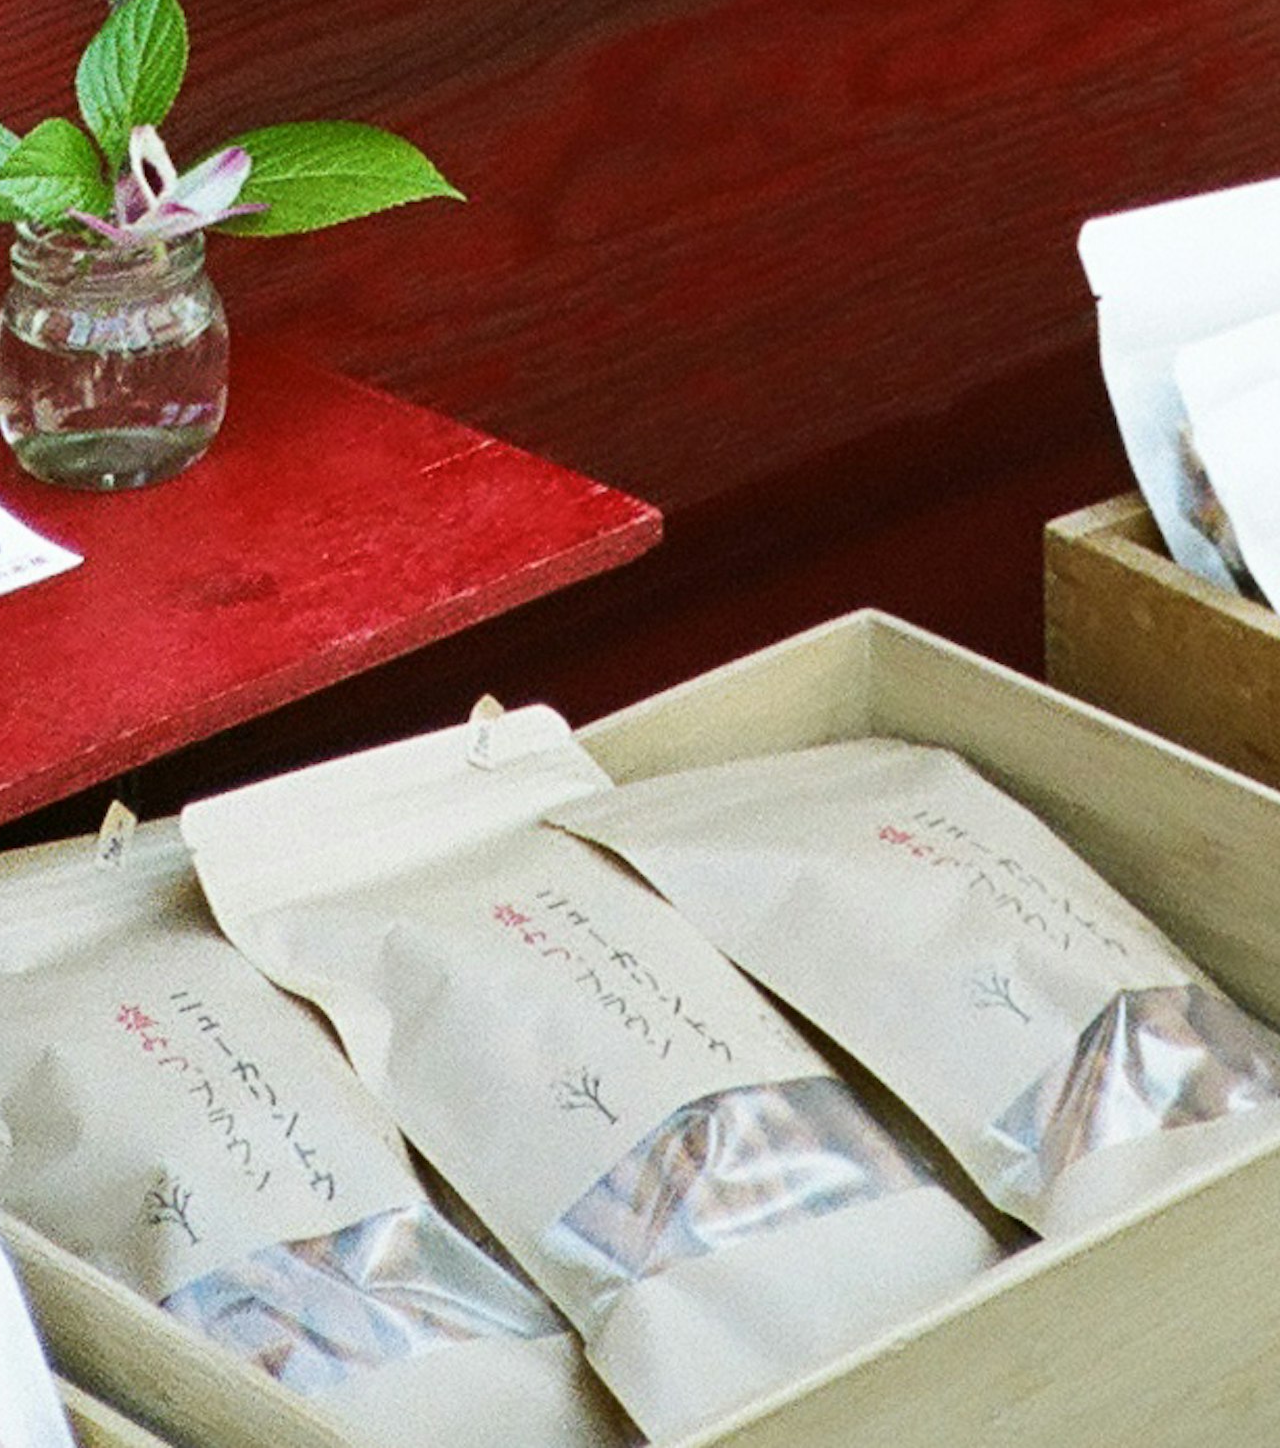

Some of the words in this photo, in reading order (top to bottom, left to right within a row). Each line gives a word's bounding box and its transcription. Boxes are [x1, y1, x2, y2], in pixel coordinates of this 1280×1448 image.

[912, 810, 1129, 957] ニューカリントウ
[536, 890, 733, 1063] ニューカリントウ
[169, 991, 338, 1201] ニューカリントウ
